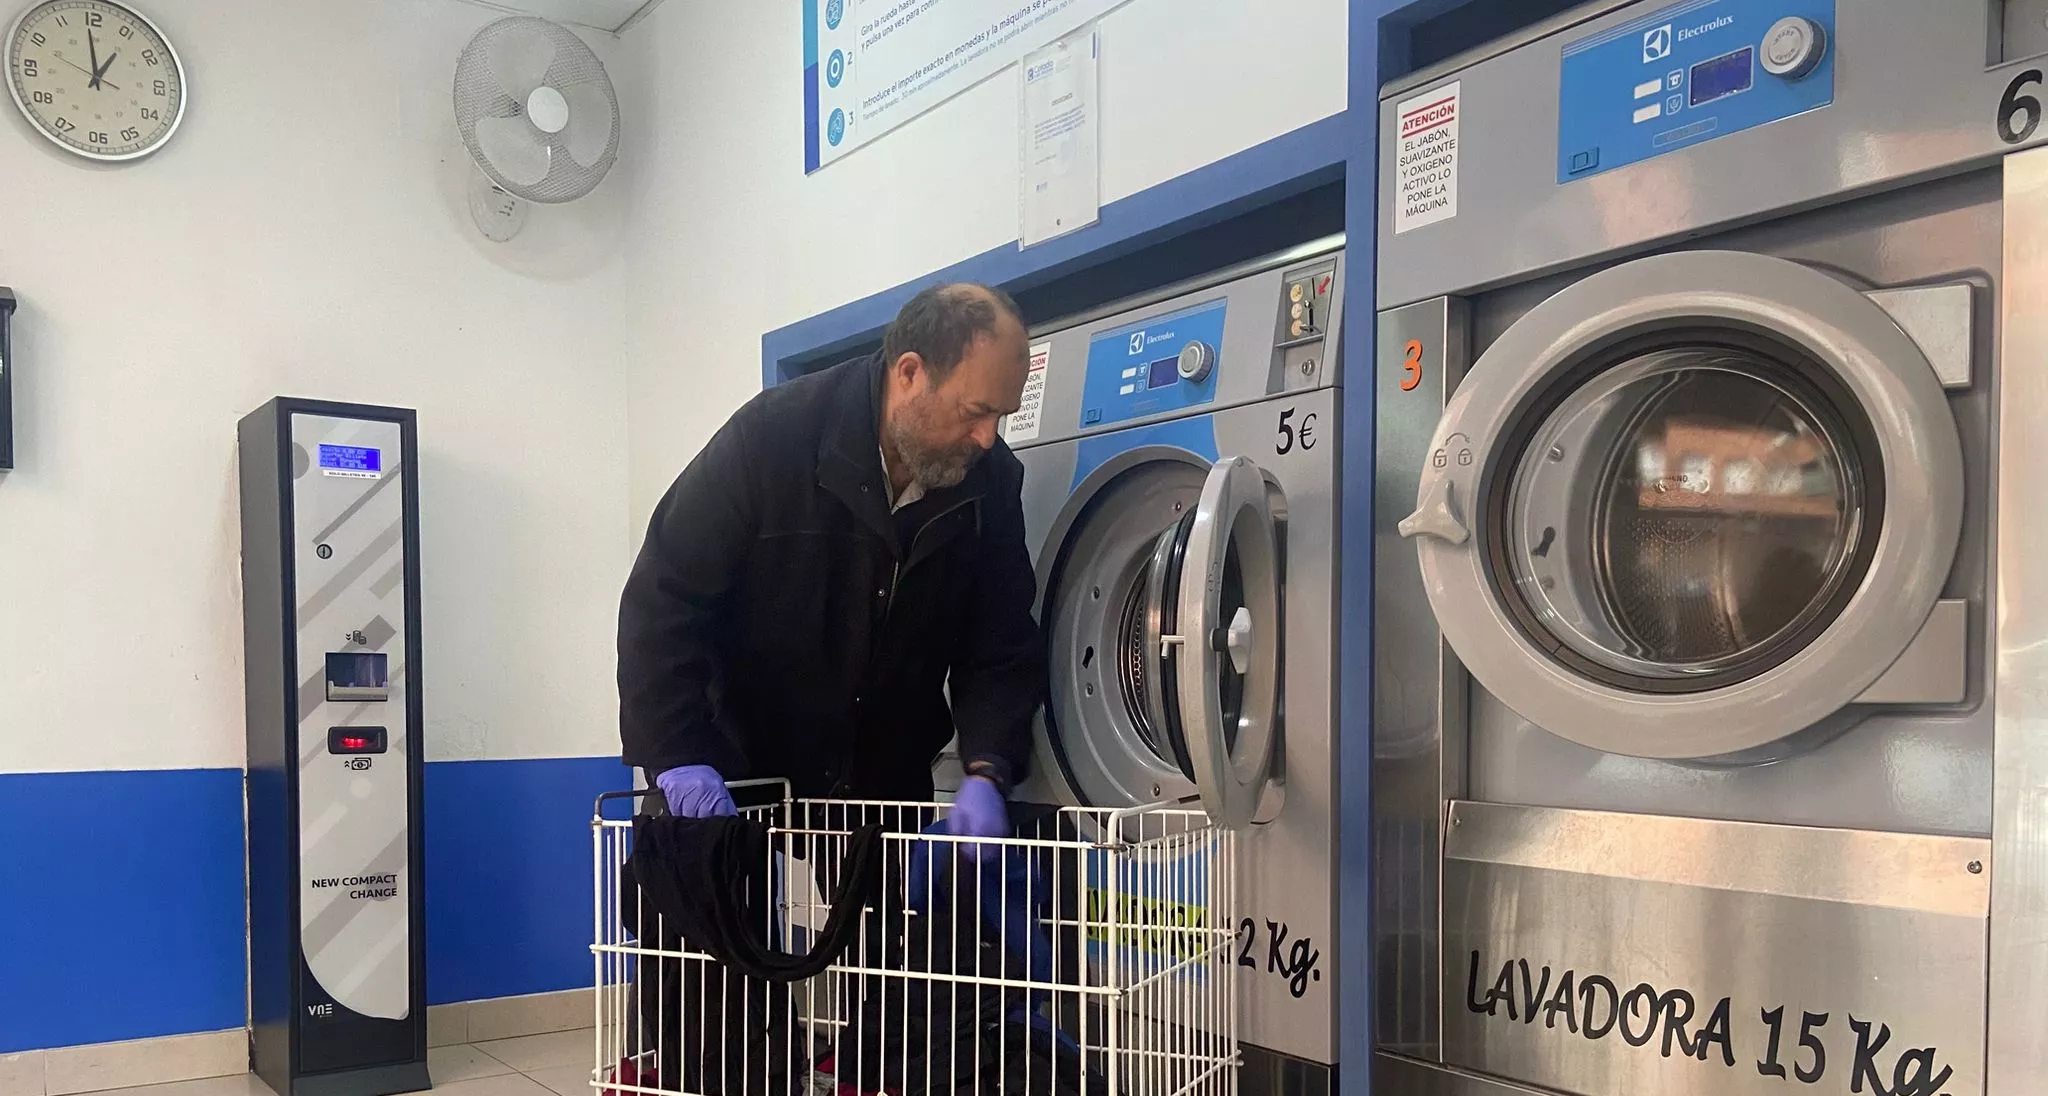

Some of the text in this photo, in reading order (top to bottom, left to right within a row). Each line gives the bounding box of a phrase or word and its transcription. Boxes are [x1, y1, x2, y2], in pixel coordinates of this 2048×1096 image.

[56, 16, 68, 27] 11
[86, 12, 103, 27] 12
[861, 23, 873, 36] Gira
[874, 19, 879, 27] la
[881, 8, 897, 24] rueda
[119, 26, 134, 40] 01
[866, 32, 881, 50] pulsa
[882, 25, 893, 37] una
[895, 17, 905, 27] vez
[906, 8, 919, 25] para
[1678, 15, 1733, 42] Electrolux
[31, 32, 46, 47] 10
[142, 49, 158, 68] 02
[848, 52, 853, 65] 2
[863, 87, 891, 109] Introduce
[892, 82, 897, 93] el
[898, 69, 922, 89] importe
[923, 57, 944, 74] exacto
[945, 51, 953, 61] en
[955, 32, 984, 56] monedas
[986, 29, 990, 40] y
[992, 24, 998, 35] la
[1000, 6, 1030, 29] máquina
[1033, 1, 1040, 10] se
[24, 59, 37, 77] 09
[153, 80, 165, 96] 03
[34, 91, 52, 104] 08
[141, 108, 159, 120] 04
[1997, 70, 2042, 144] 6
[55, 117, 75, 134] 07
[849, 111, 854, 125] 3
[1402, 104, 1455, 132] ATENCIÓN
[89, 132, 108, 144] 06
[121, 127, 139, 141] 05
[1405, 128, 1450, 152] EL JABÓN,
[1400, 139, 1456, 167] SUAVIZANTE
[1403, 154, 1452, 179] Y OXIGENO
[1403, 168, 1451, 192] ACTIVO LO
[1407, 183, 1446, 204] PONE LA
[1406, 196, 1448, 218] MÁQUINA
[1147, 330, 1175, 345] Electrolux
[1030, 357, 1046, 367] CIÓN
[1399, 338, 1423, 391] 3
[1025, 382, 1044, 392] IZANTE
[1013, 413, 1027, 422] PONE
[1011, 422, 1034, 432] MÁQUINA
[1276, 407, 1317, 455] 5€
[312, 875, 397, 888] NEW COMPACT
[350, 888, 397, 899] CHANGE
[1266, 915, 1320, 998] Kg.
[1466, 950, 1954, 1096] LAVADORA 15 Kg
